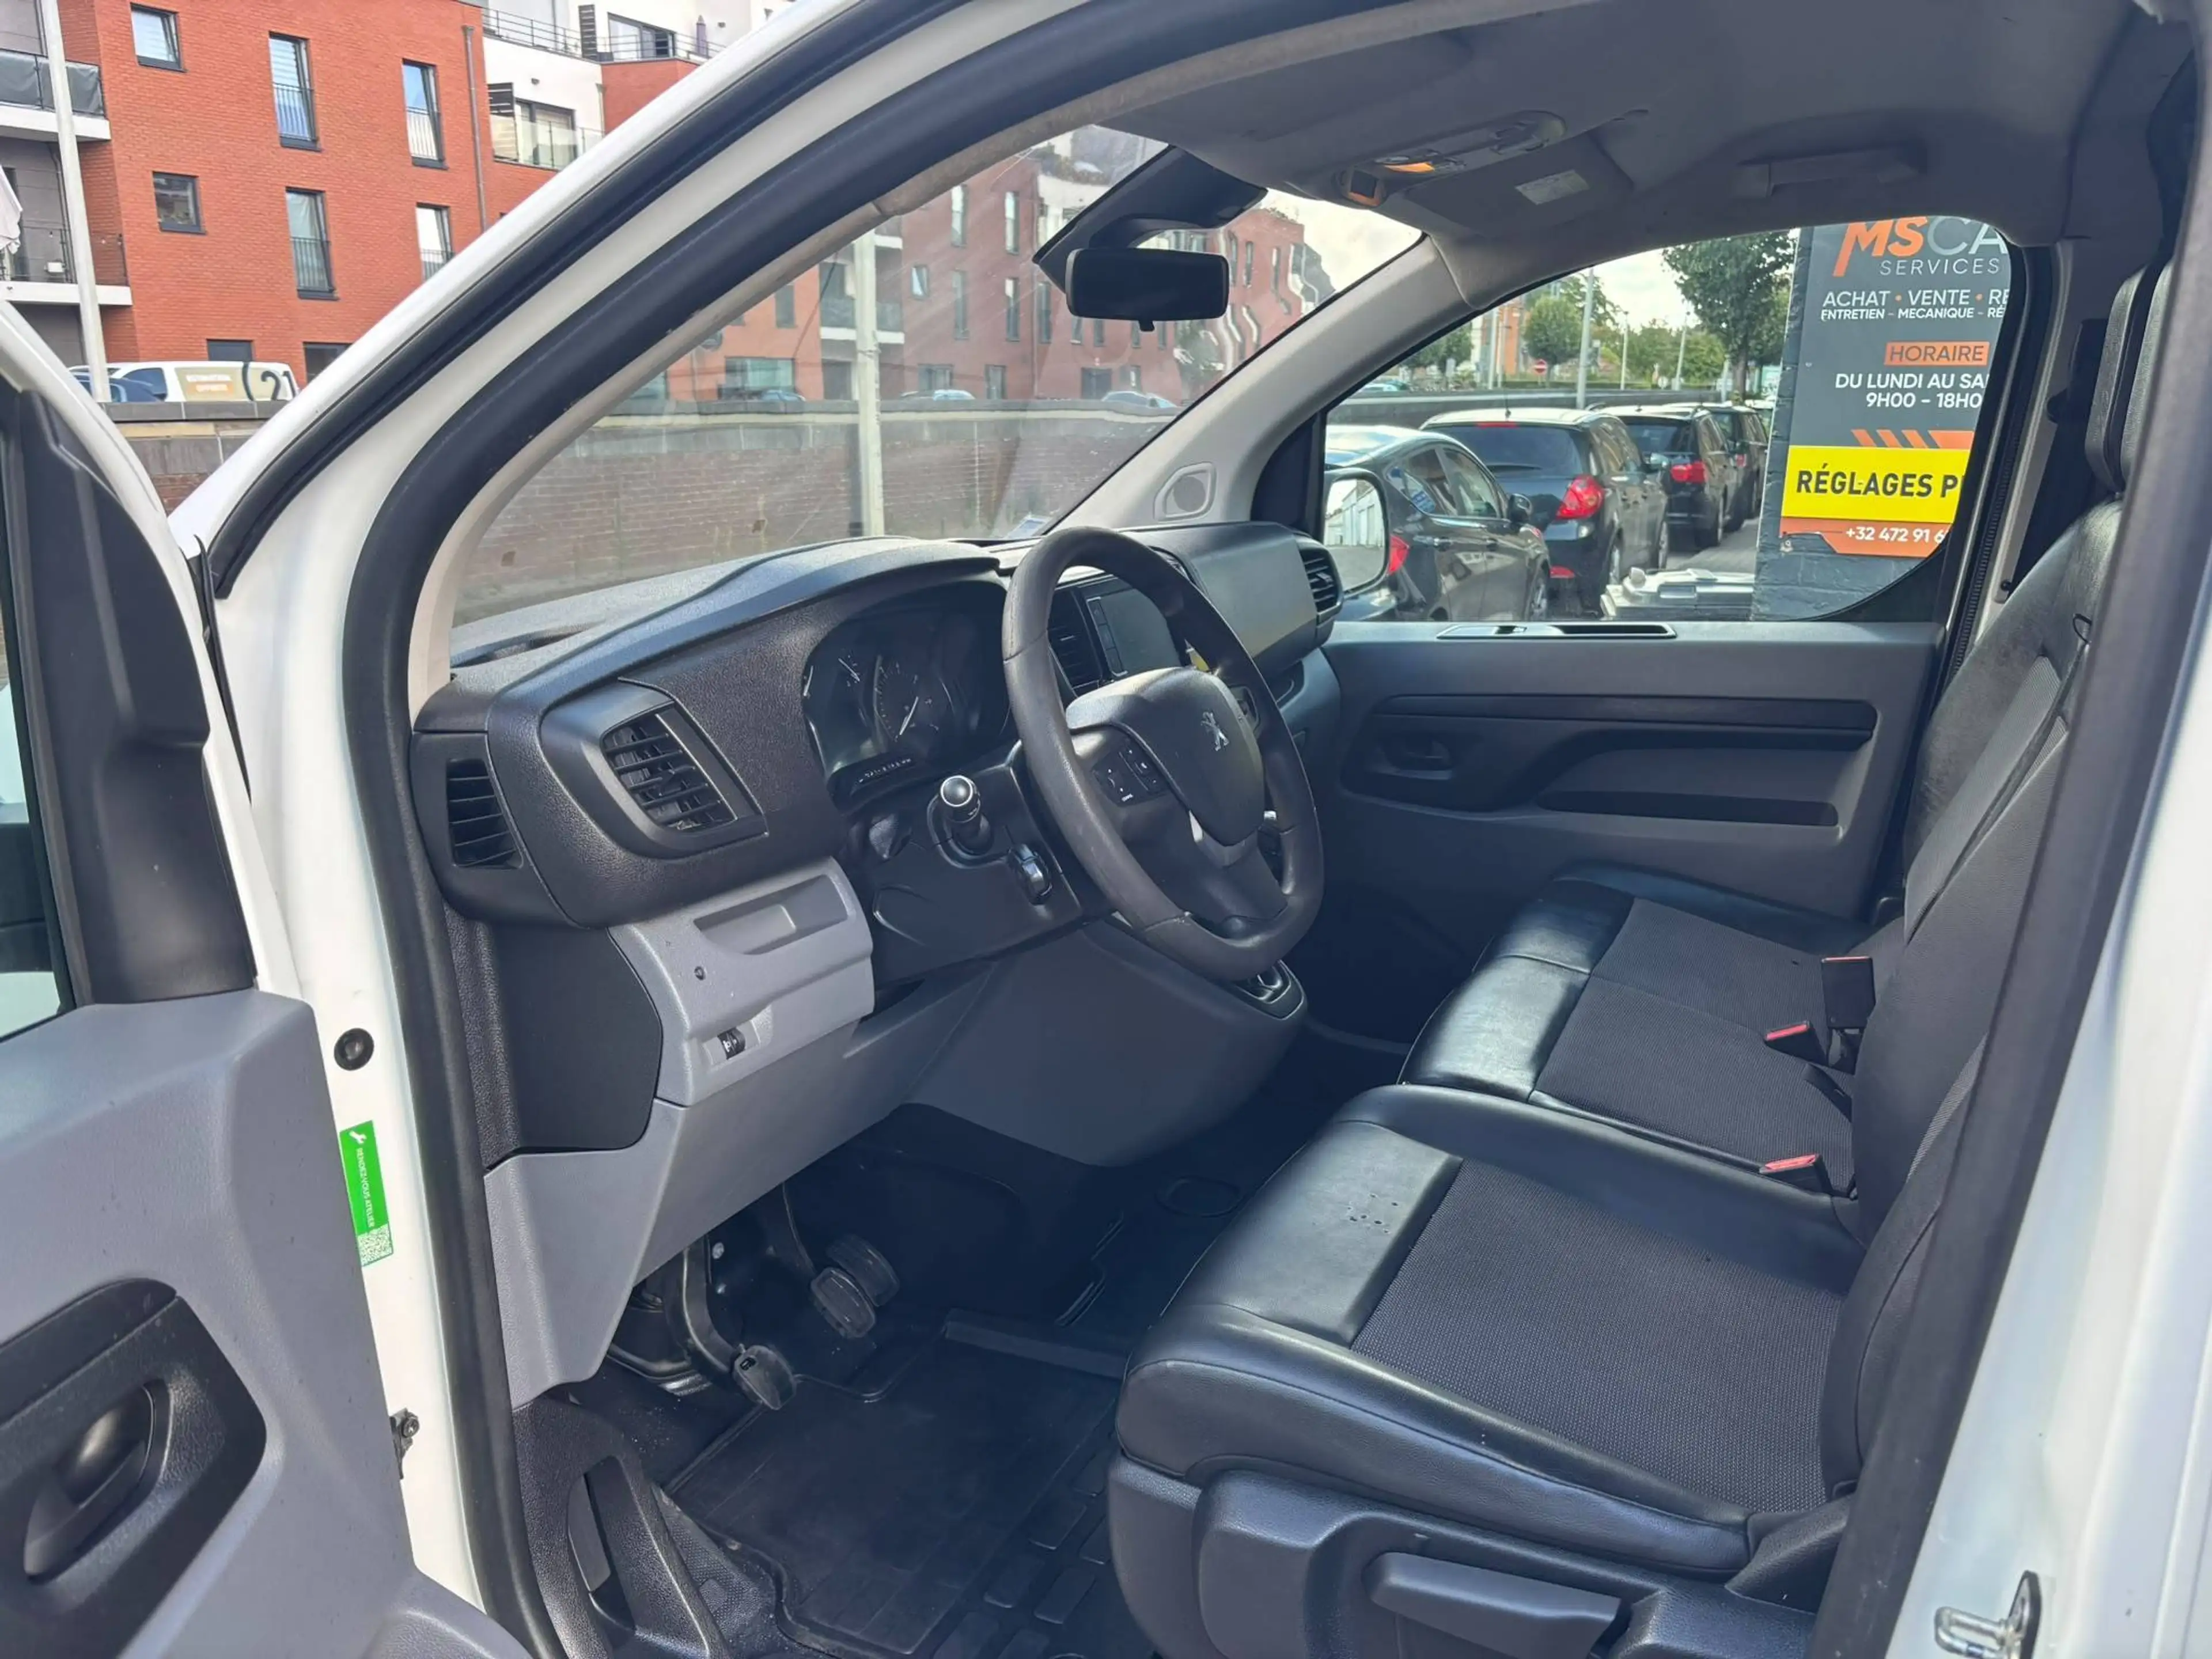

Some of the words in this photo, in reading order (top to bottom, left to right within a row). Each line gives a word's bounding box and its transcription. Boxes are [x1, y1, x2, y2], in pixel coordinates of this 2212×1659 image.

[1880, 258, 2000, 275] SERVICES
[1823, 290, 1891, 306] ACHAT
[1908, 289, 1971, 306] VENTE
[1821, 309, 1885, 321] ENTRETIEN
[1898, 308, 1975, 319] MECANIQUE
[1987, 304, 2005, 318] RÉ
[1890, 345, 1984, 362] HORAIRE
[1835, 373, 1863, 389] DU
[1867, 373, 1923, 389] LUNDI
[1927, 373, 1955, 389] AU
[1866, 392, 1916, 408] 9H00
[1936, 393, 1982, 408] 18H0
[1797, 463, 1933, 497] RÉGLAGES
[1940, 474, 1965, 498] P
[1846, 527, 1874, 541] +32
[1878, 527, 1908, 541] 472
[1912, 528, 1930, 543] 91
[365, 1199, 375, 1228] ATELIER
